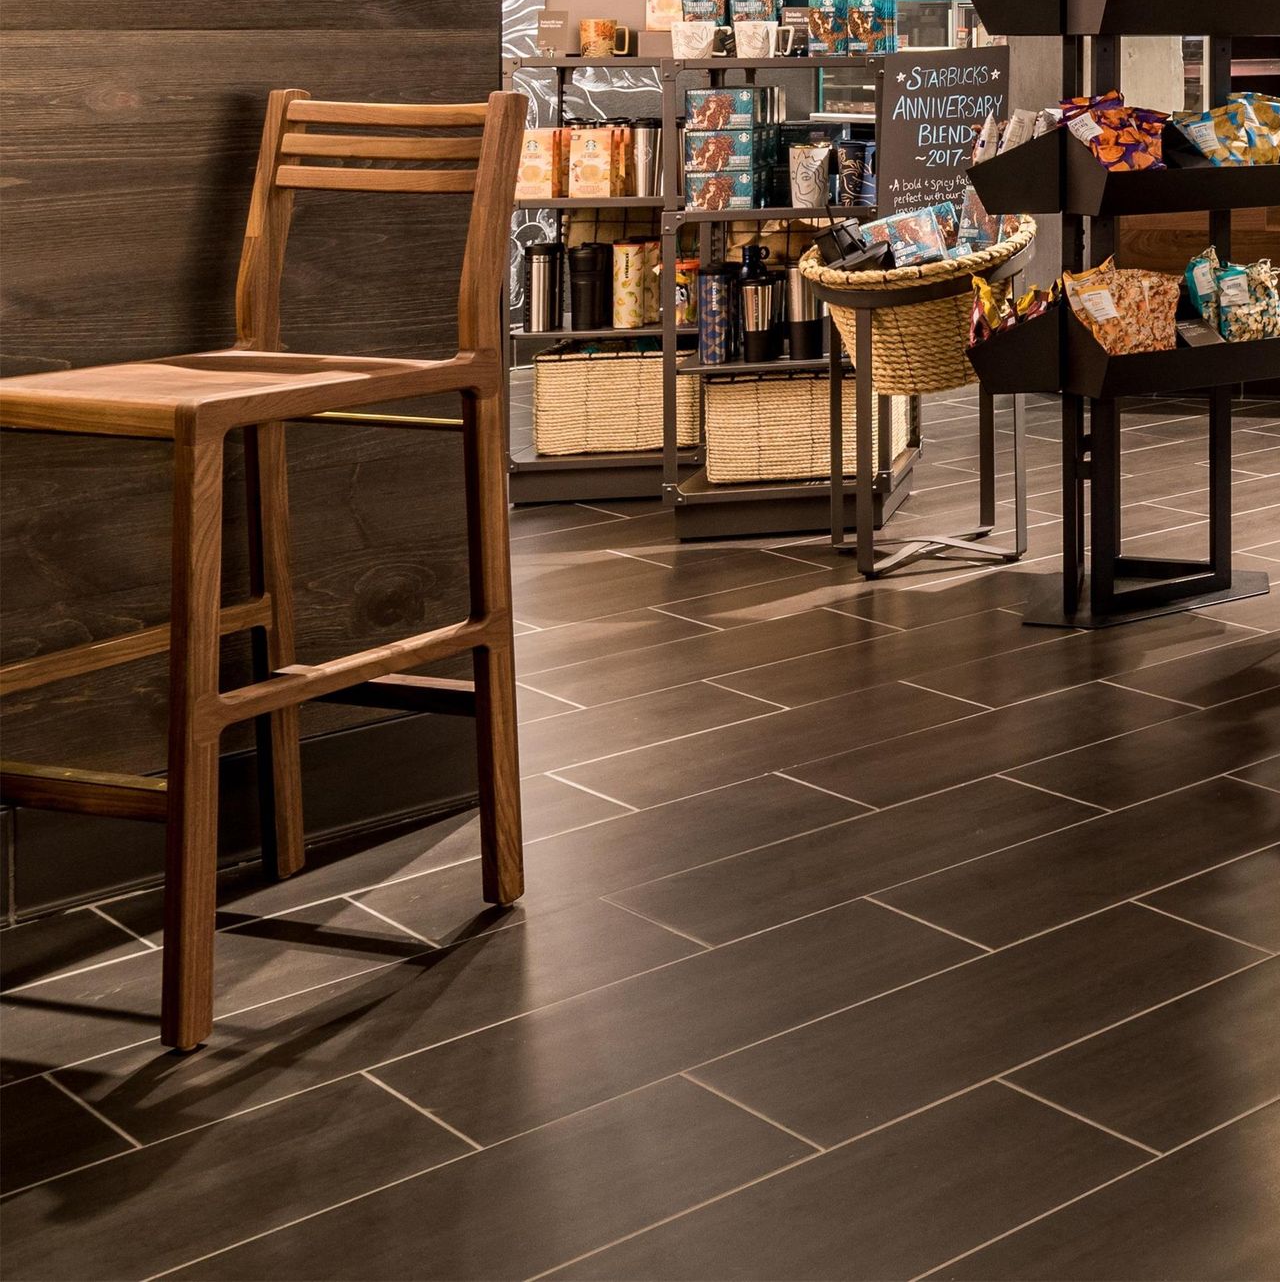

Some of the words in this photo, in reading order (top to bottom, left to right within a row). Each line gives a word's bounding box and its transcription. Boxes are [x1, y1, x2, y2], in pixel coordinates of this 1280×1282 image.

[906, 65, 989, 91] STARBUCKS
[892, 94, 1003, 121] ANNIVERSARY
[918, 123, 975, 147] BLEND
[902, 178, 922, 191] bold
[930, 179, 955, 193] spicy
[893, 192, 922, 207] perfect
[924, 192, 945, 201] with
[945, 192, 961, 200] our
